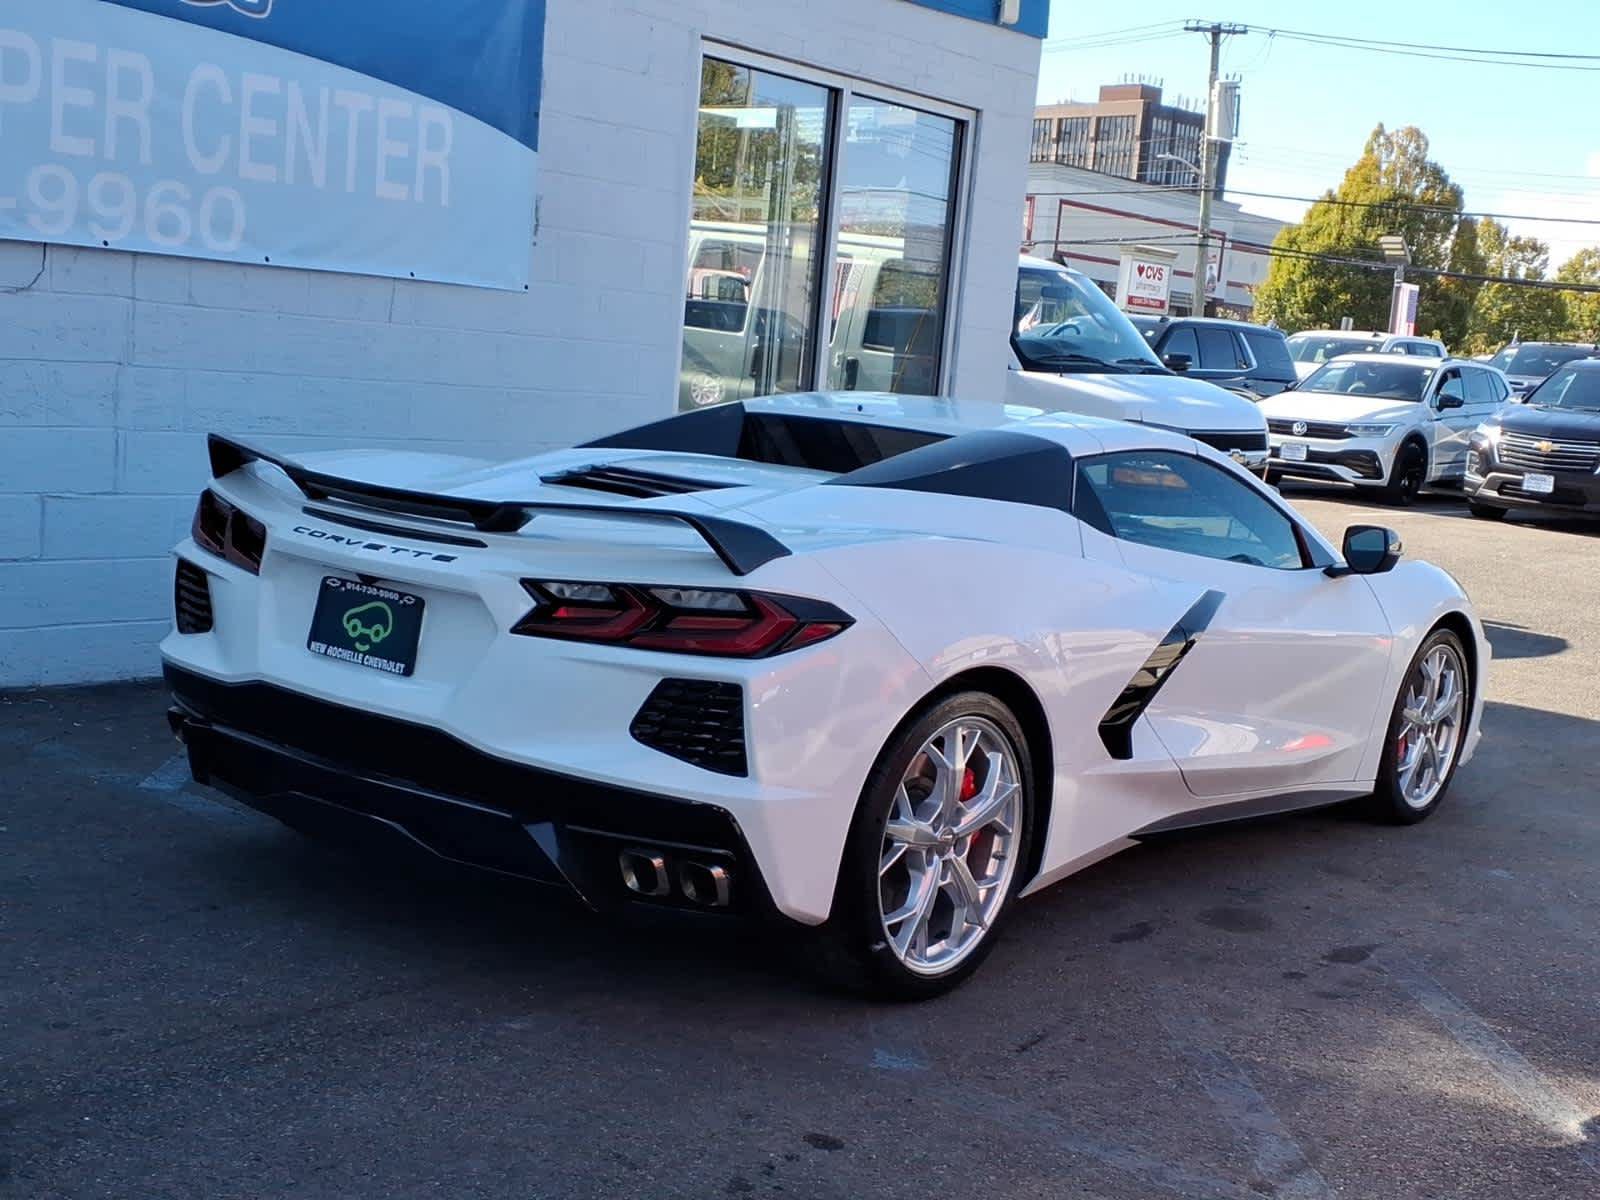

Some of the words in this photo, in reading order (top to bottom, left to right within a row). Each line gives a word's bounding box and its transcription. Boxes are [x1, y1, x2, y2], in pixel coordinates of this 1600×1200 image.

[181, 63, 454, 208] CENTER
[1145, 265, 1164, 281] CVS
[293, 526, 458, 563] CORVETTE
[310, 641, 328, 654] NEW
[327, 645, 363, 664] ROCHELLE
[363, 655, 406, 674] CHEVROLET
